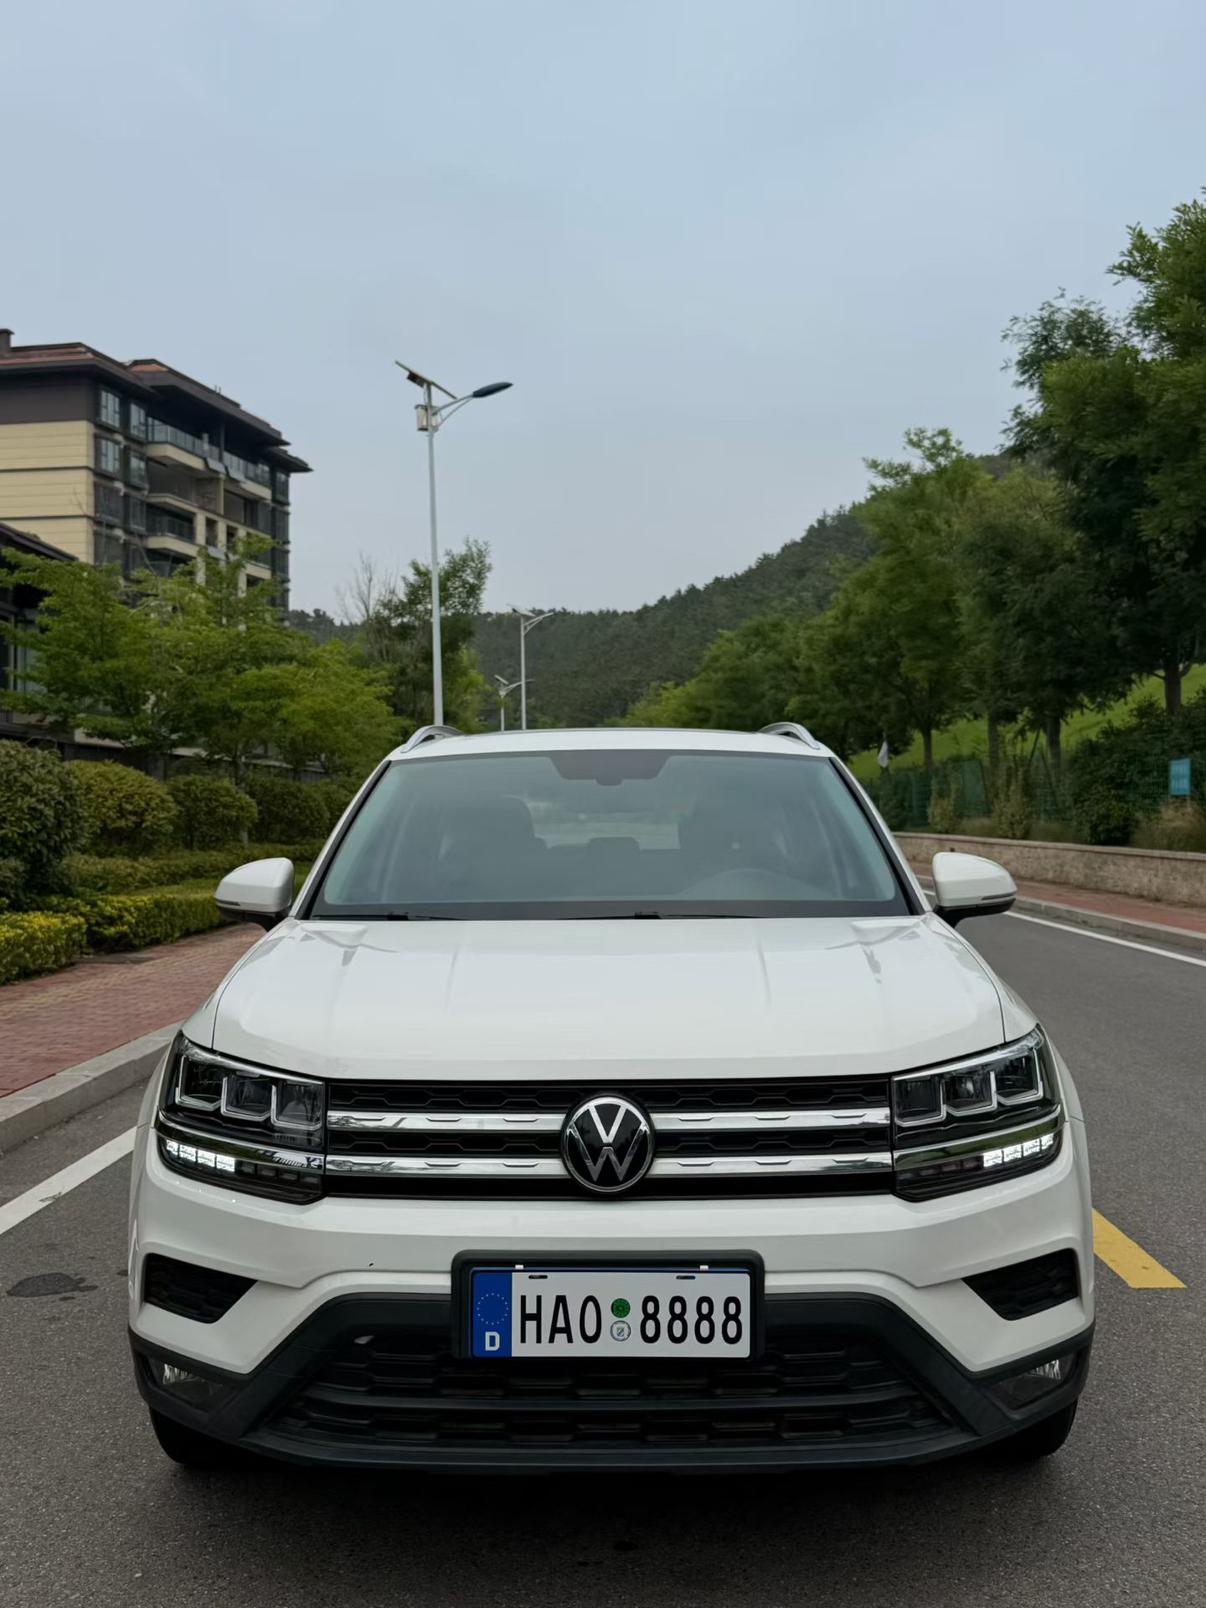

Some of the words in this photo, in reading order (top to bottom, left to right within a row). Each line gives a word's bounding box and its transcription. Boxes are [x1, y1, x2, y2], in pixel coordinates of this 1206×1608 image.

[567, 1103, 648, 1182] VW
[485, 1331, 500, 1351] D
[520, 1294, 602, 1344] HAO
[640, 1295, 743, 1345] 8888
